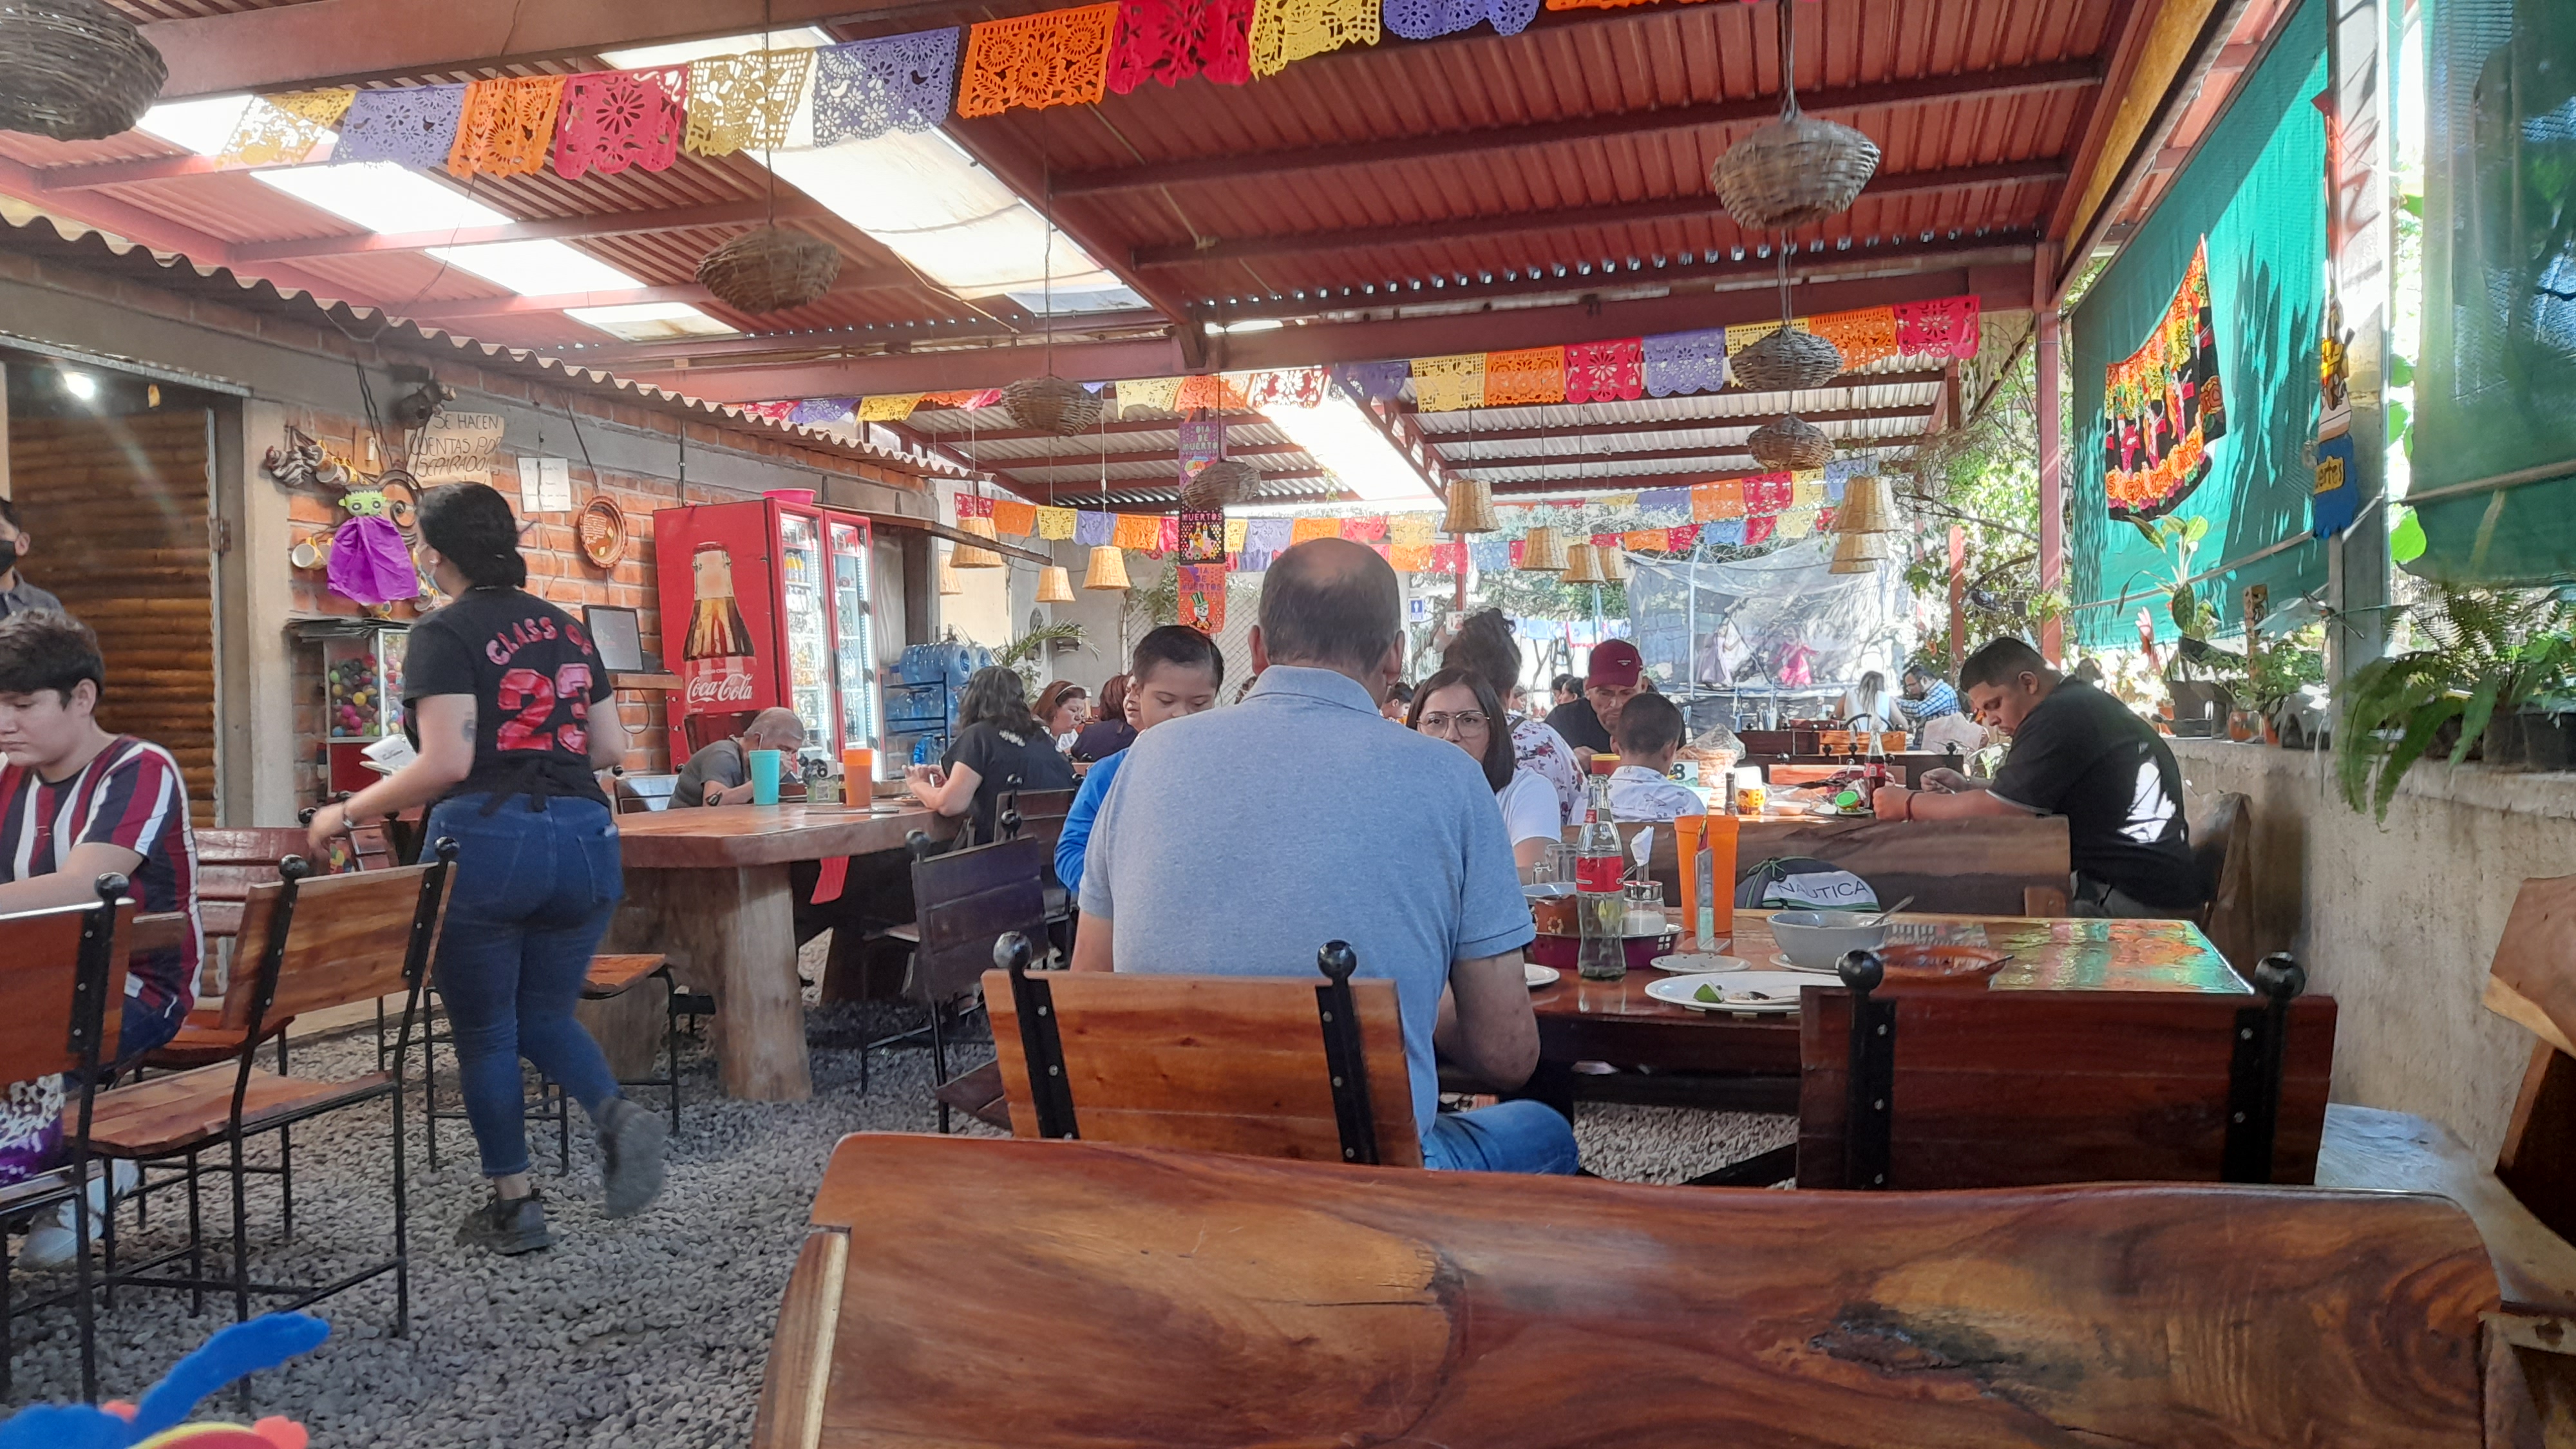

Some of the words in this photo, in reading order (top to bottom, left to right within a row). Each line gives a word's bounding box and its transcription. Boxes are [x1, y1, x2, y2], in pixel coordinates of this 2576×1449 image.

[433, 413, 451, 430] SE
[458, 413, 498, 430] HACEN
[410, 433, 471, 456] CUENTAS
[1182, 442, 1222, 451] MUERTO
[1182, 513, 1223, 522] MUERTOS
[486, 616, 558, 666] CLASS
[687, 673, 754, 704] Coca-Cola
[496, 662, 594, 755] 23
[1777, 880, 1870, 900] NAUTICA
